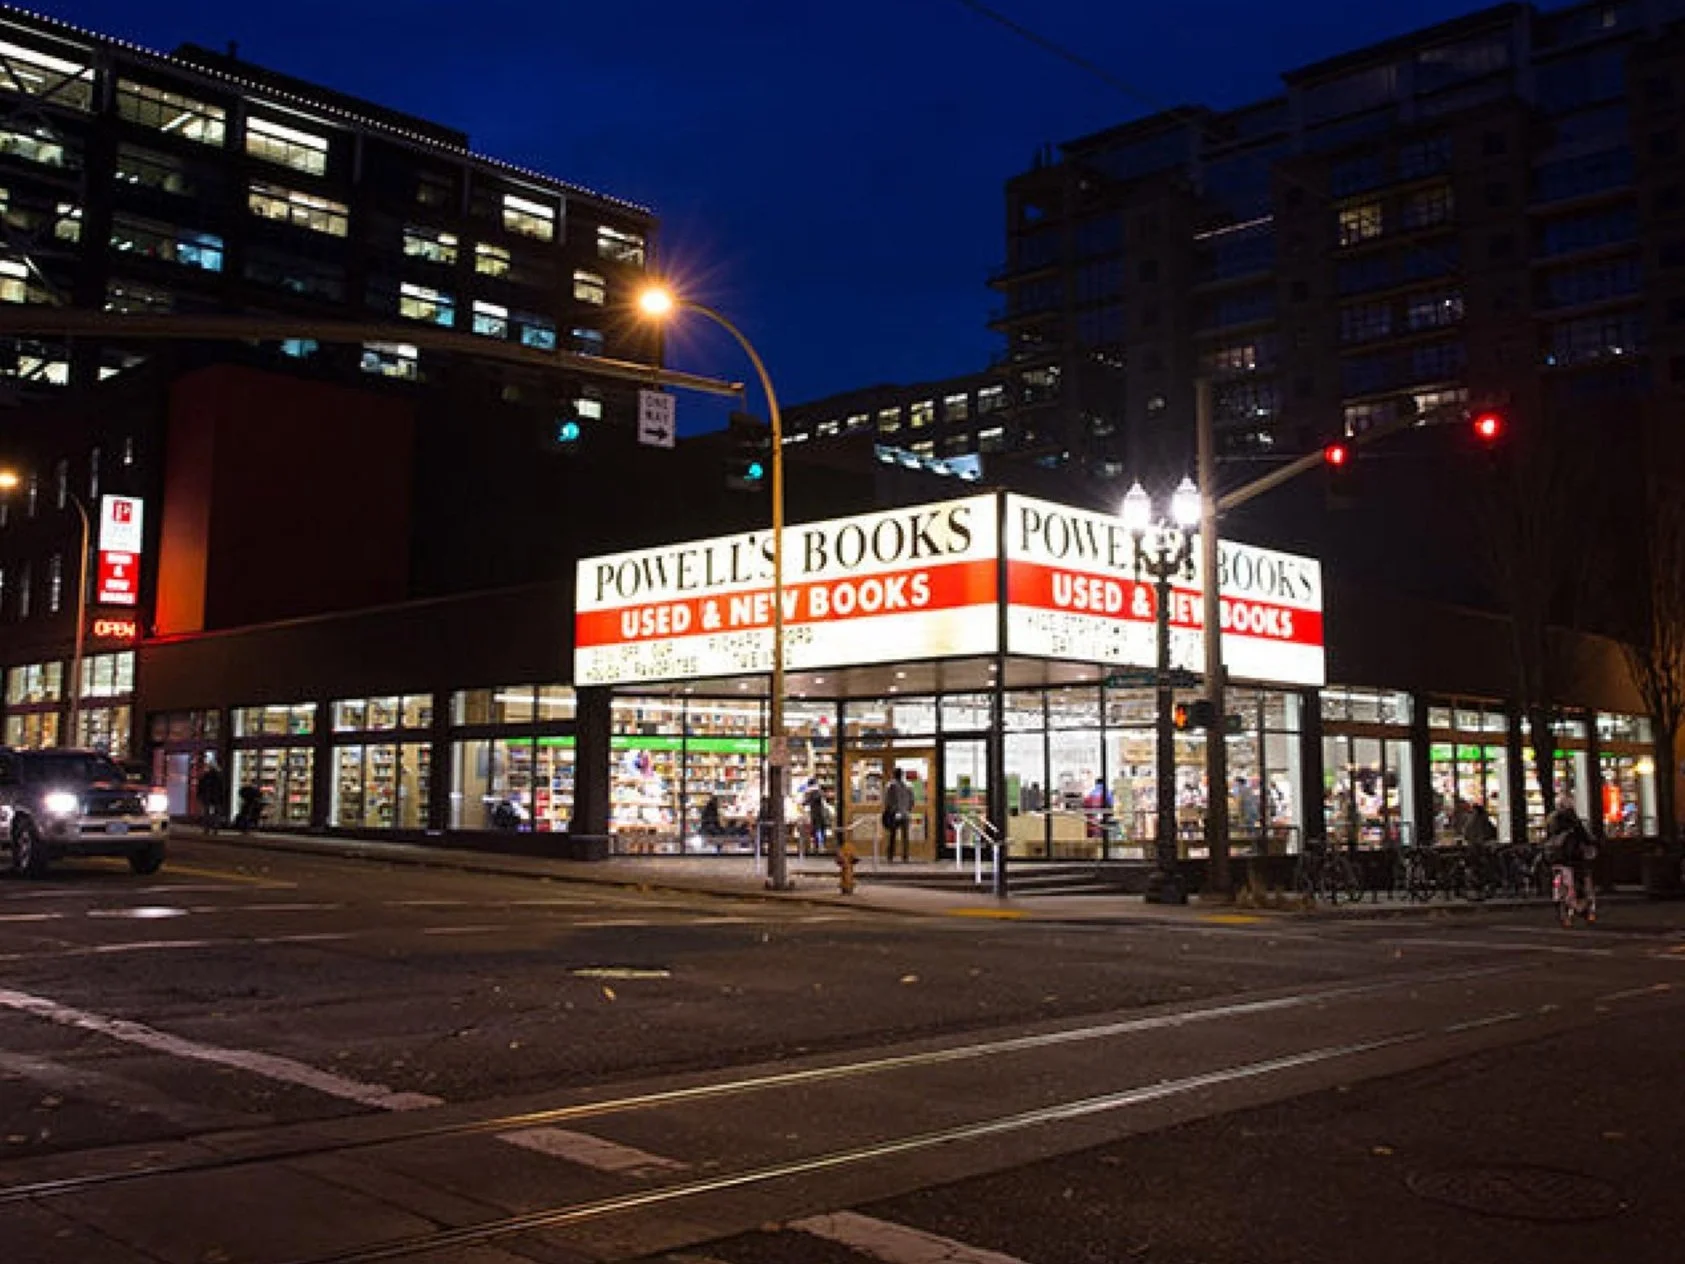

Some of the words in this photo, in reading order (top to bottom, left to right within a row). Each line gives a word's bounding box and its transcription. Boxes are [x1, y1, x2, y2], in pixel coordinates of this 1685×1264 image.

[646, 396, 669, 409] ONE
[646, 411, 669, 426] WAY
[595, 535, 776, 602] POWELL'S
[803, 507, 971, 573] BOOKS
[1020, 507, 1195, 581] POWE'
[1217, 546, 1315, 601] BOOKS
[94, 620, 136, 637] OPEN
[621, 604, 692, 639] USED
[703, 600, 722, 629] &
[730, 590, 798, 626] NEW
[808, 572, 931, 617] BOOKS
[1052, 573, 1122, 613] USED
[1132, 585, 1150, 617] &
[1219, 601, 1293, 638] BOOKS
